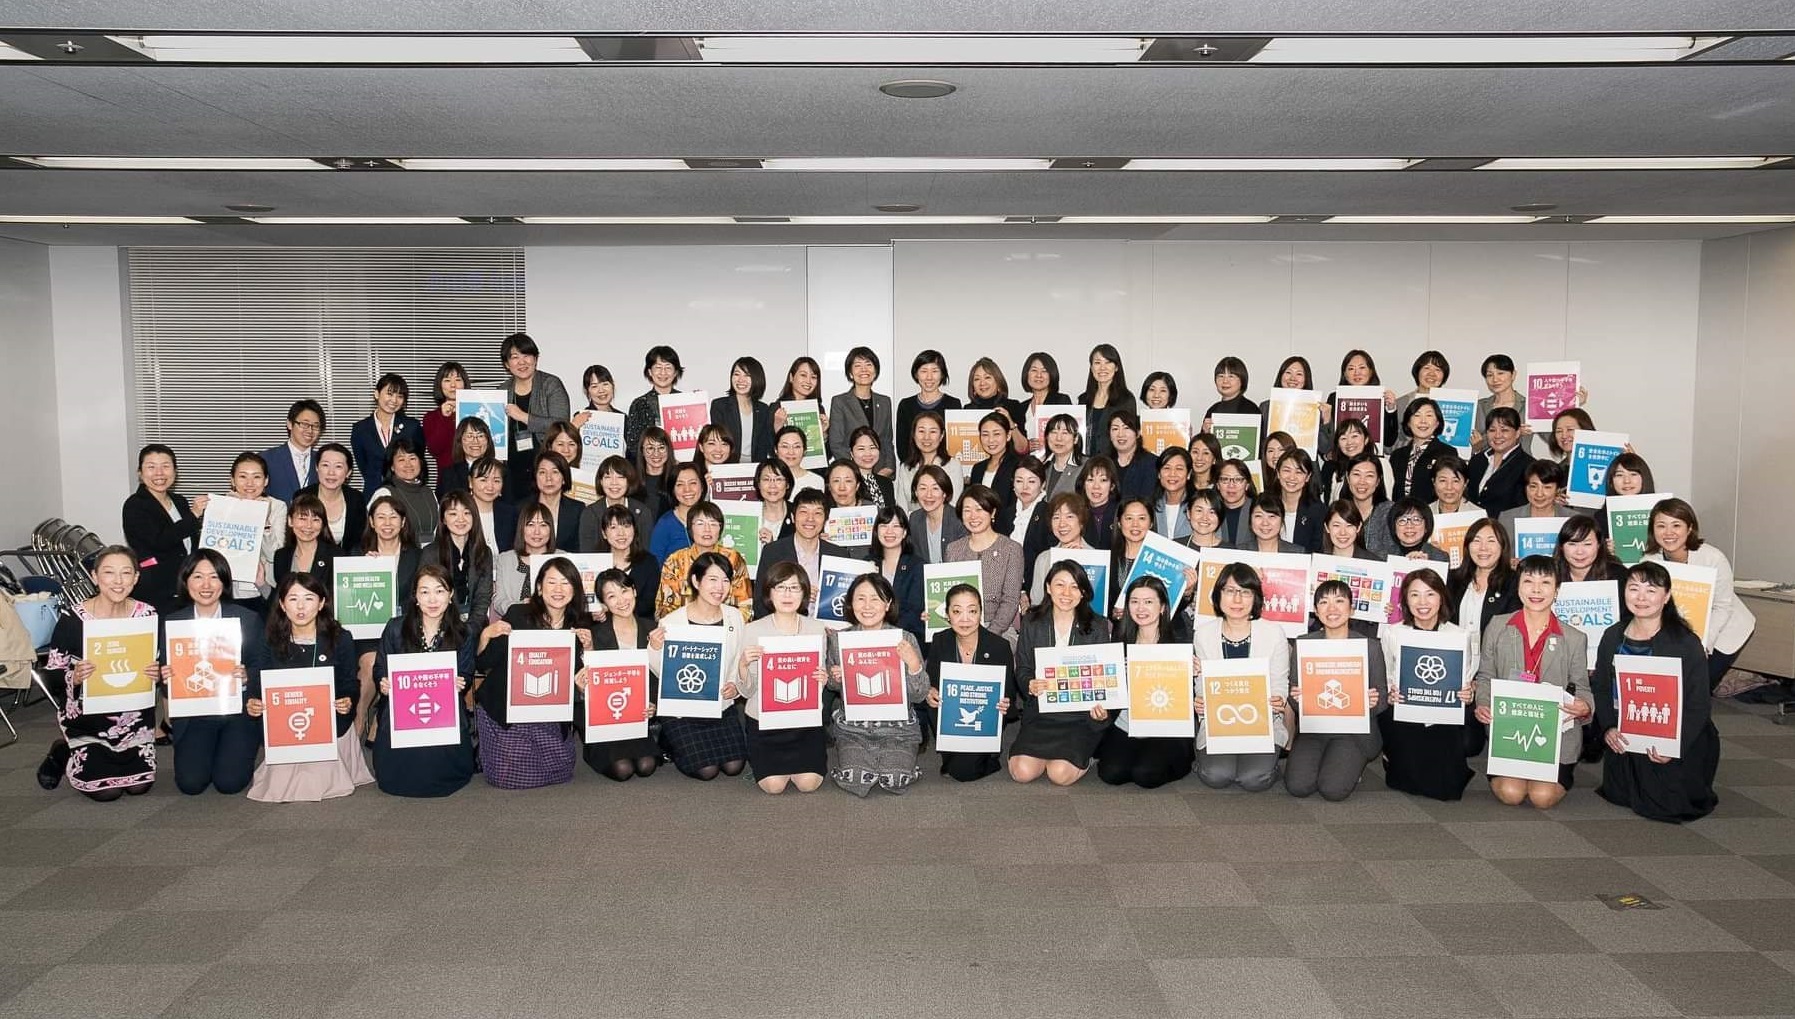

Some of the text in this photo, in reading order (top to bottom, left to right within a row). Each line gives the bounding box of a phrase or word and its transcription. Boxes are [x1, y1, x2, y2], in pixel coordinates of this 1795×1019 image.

[1340, 401, 1346, 412] 8
[1215, 429, 1224, 439] 13
[583, 435, 620, 449] GOALS
[1578, 447, 1585, 459] 6
[716, 481, 722, 493] 8
[1615, 514, 1623, 527] 3
[205, 535, 256, 552] GOALS
[1521, 537, 1533, 550] 14
[1142, 550, 1155, 565] 14
[342, 576, 349, 589] 3
[825, 574, 836, 587] 17
[930, 581, 940, 594] 13
[1555, 597, 1612, 607] SUSTAINABLE
[94, 641, 103, 655] 2
[175, 643, 184, 657] 9
[667, 645, 679, 659] 17
[517, 652, 525, 666] 4
[767, 657, 774, 671] 4
[847, 652, 855, 667] 4
[1306, 662, 1313, 676] 9
[397, 675, 411, 690] 10
[592, 671, 600, 686] 5
[1625, 677, 1632, 692] 1
[946, 683, 958, 697] 16
[1209, 681, 1221, 695] 12
[1636, 685, 1656, 694] POVERTY
[271, 692, 280, 706] 5
[1444, 690, 1457, 703] 17
[1499, 700, 1507, 715] 3
